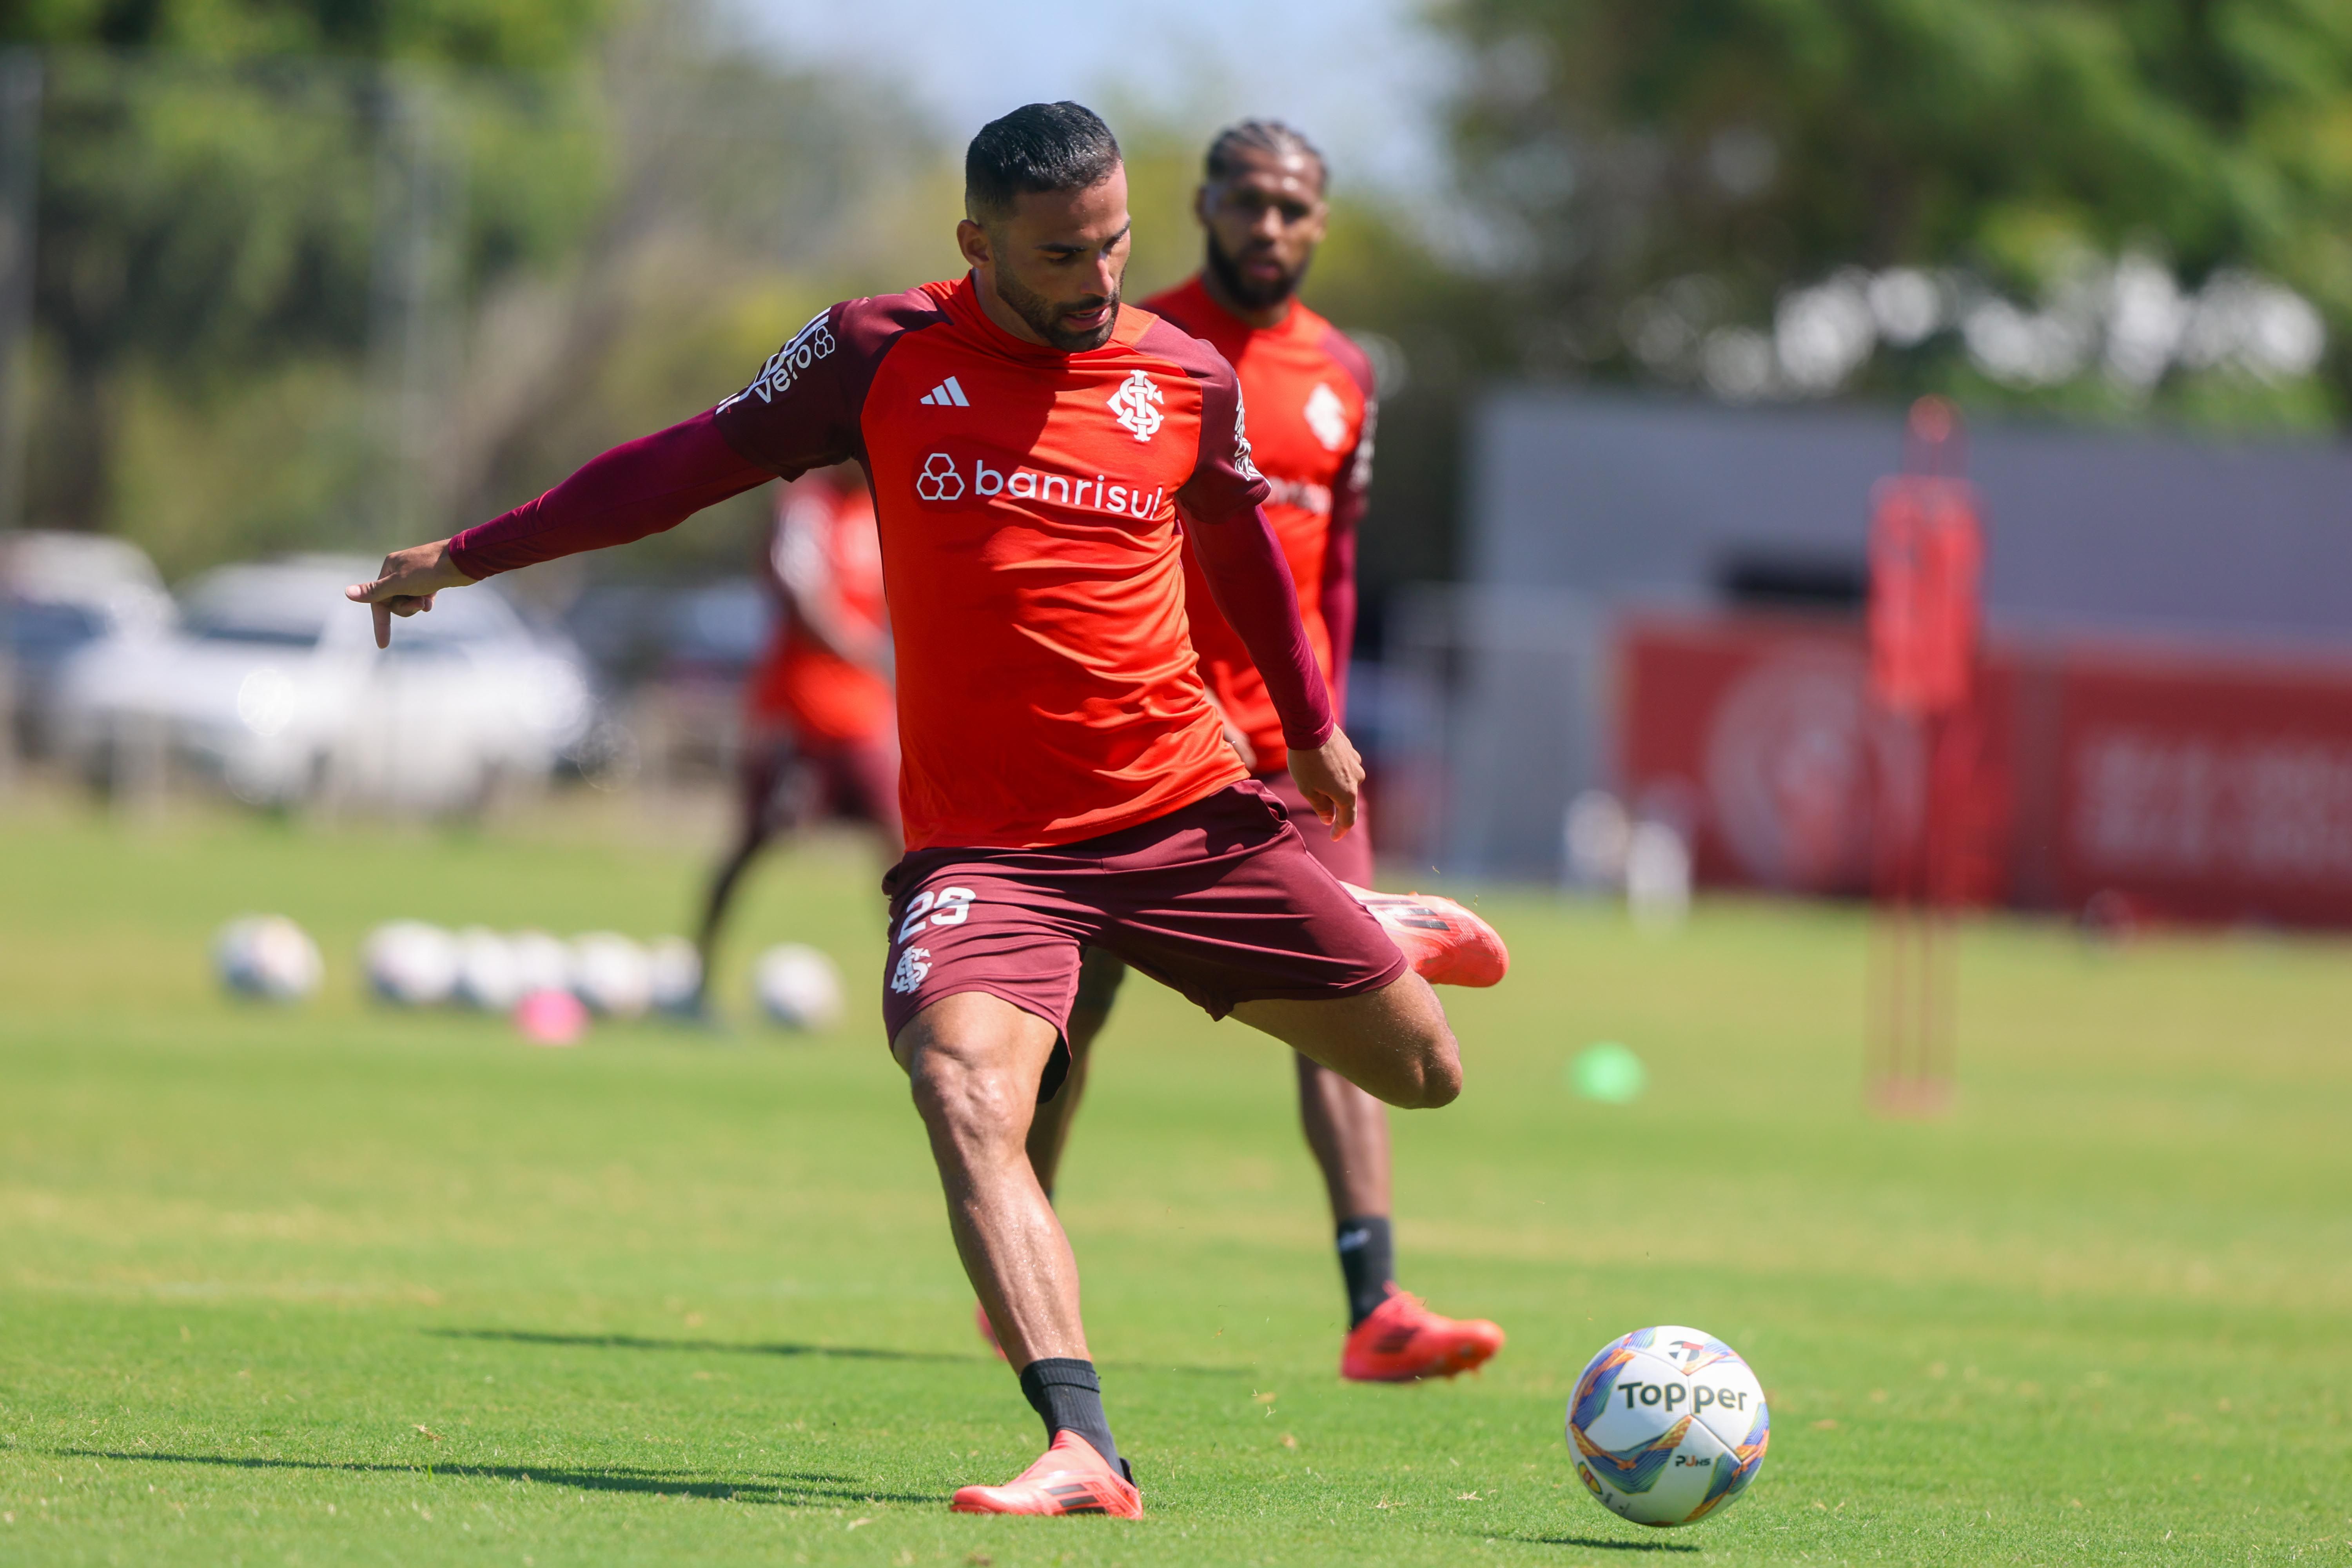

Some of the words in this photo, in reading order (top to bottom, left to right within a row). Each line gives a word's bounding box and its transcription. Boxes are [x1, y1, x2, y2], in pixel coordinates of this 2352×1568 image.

[755, 344, 811, 403] vero
[975, 459, 1162, 520] banrisul
[1617, 1381, 1748, 1414] Topper
